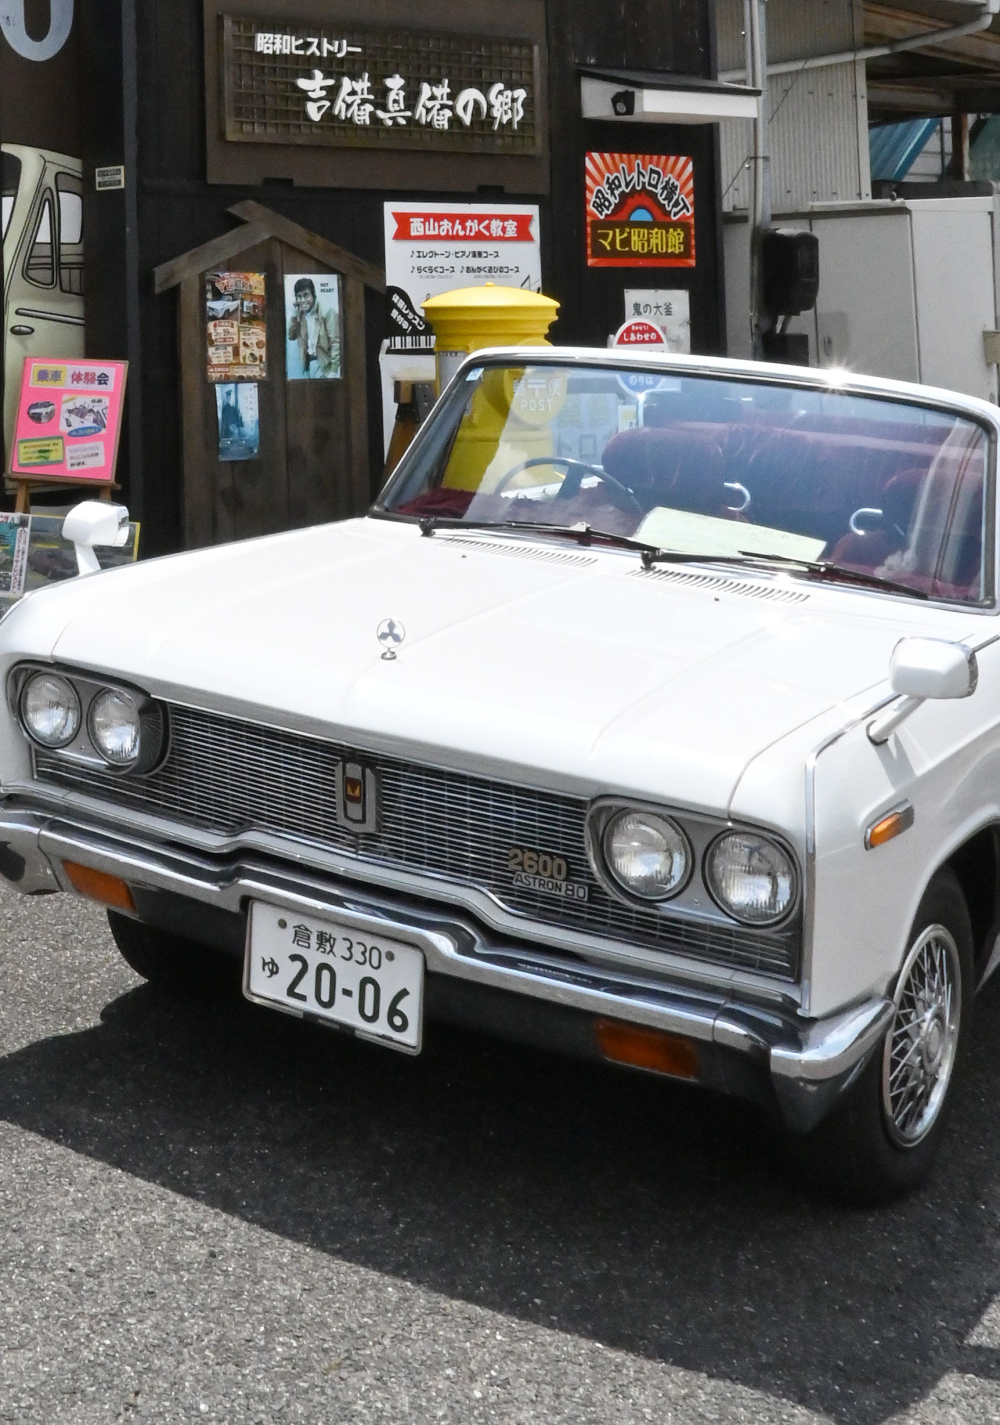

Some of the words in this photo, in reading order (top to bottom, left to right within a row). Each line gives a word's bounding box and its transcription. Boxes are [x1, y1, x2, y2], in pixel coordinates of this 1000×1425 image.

[255, 33, 362, 58] 昭和ヒストリー
[295, 69, 527, 131] 吉備真備の郷
[591, 161, 691, 218] 昭和レトロ横丁
[409, 218, 518, 238] 西山おんがく教室
[597, 227, 685, 253] マビ昭和館
[632, 302, 673, 317] 鬼の大釜
[624, 332, 657, 342] しあわせの
[629, 376, 654, 386] のりば
[520, 398, 554, 413] POST
[507, 848, 568, 881] 2600
[513, 872, 563, 893] ASTRON
[564, 881, 588, 900] 80
[286, 953, 411, 1034] 20-06
